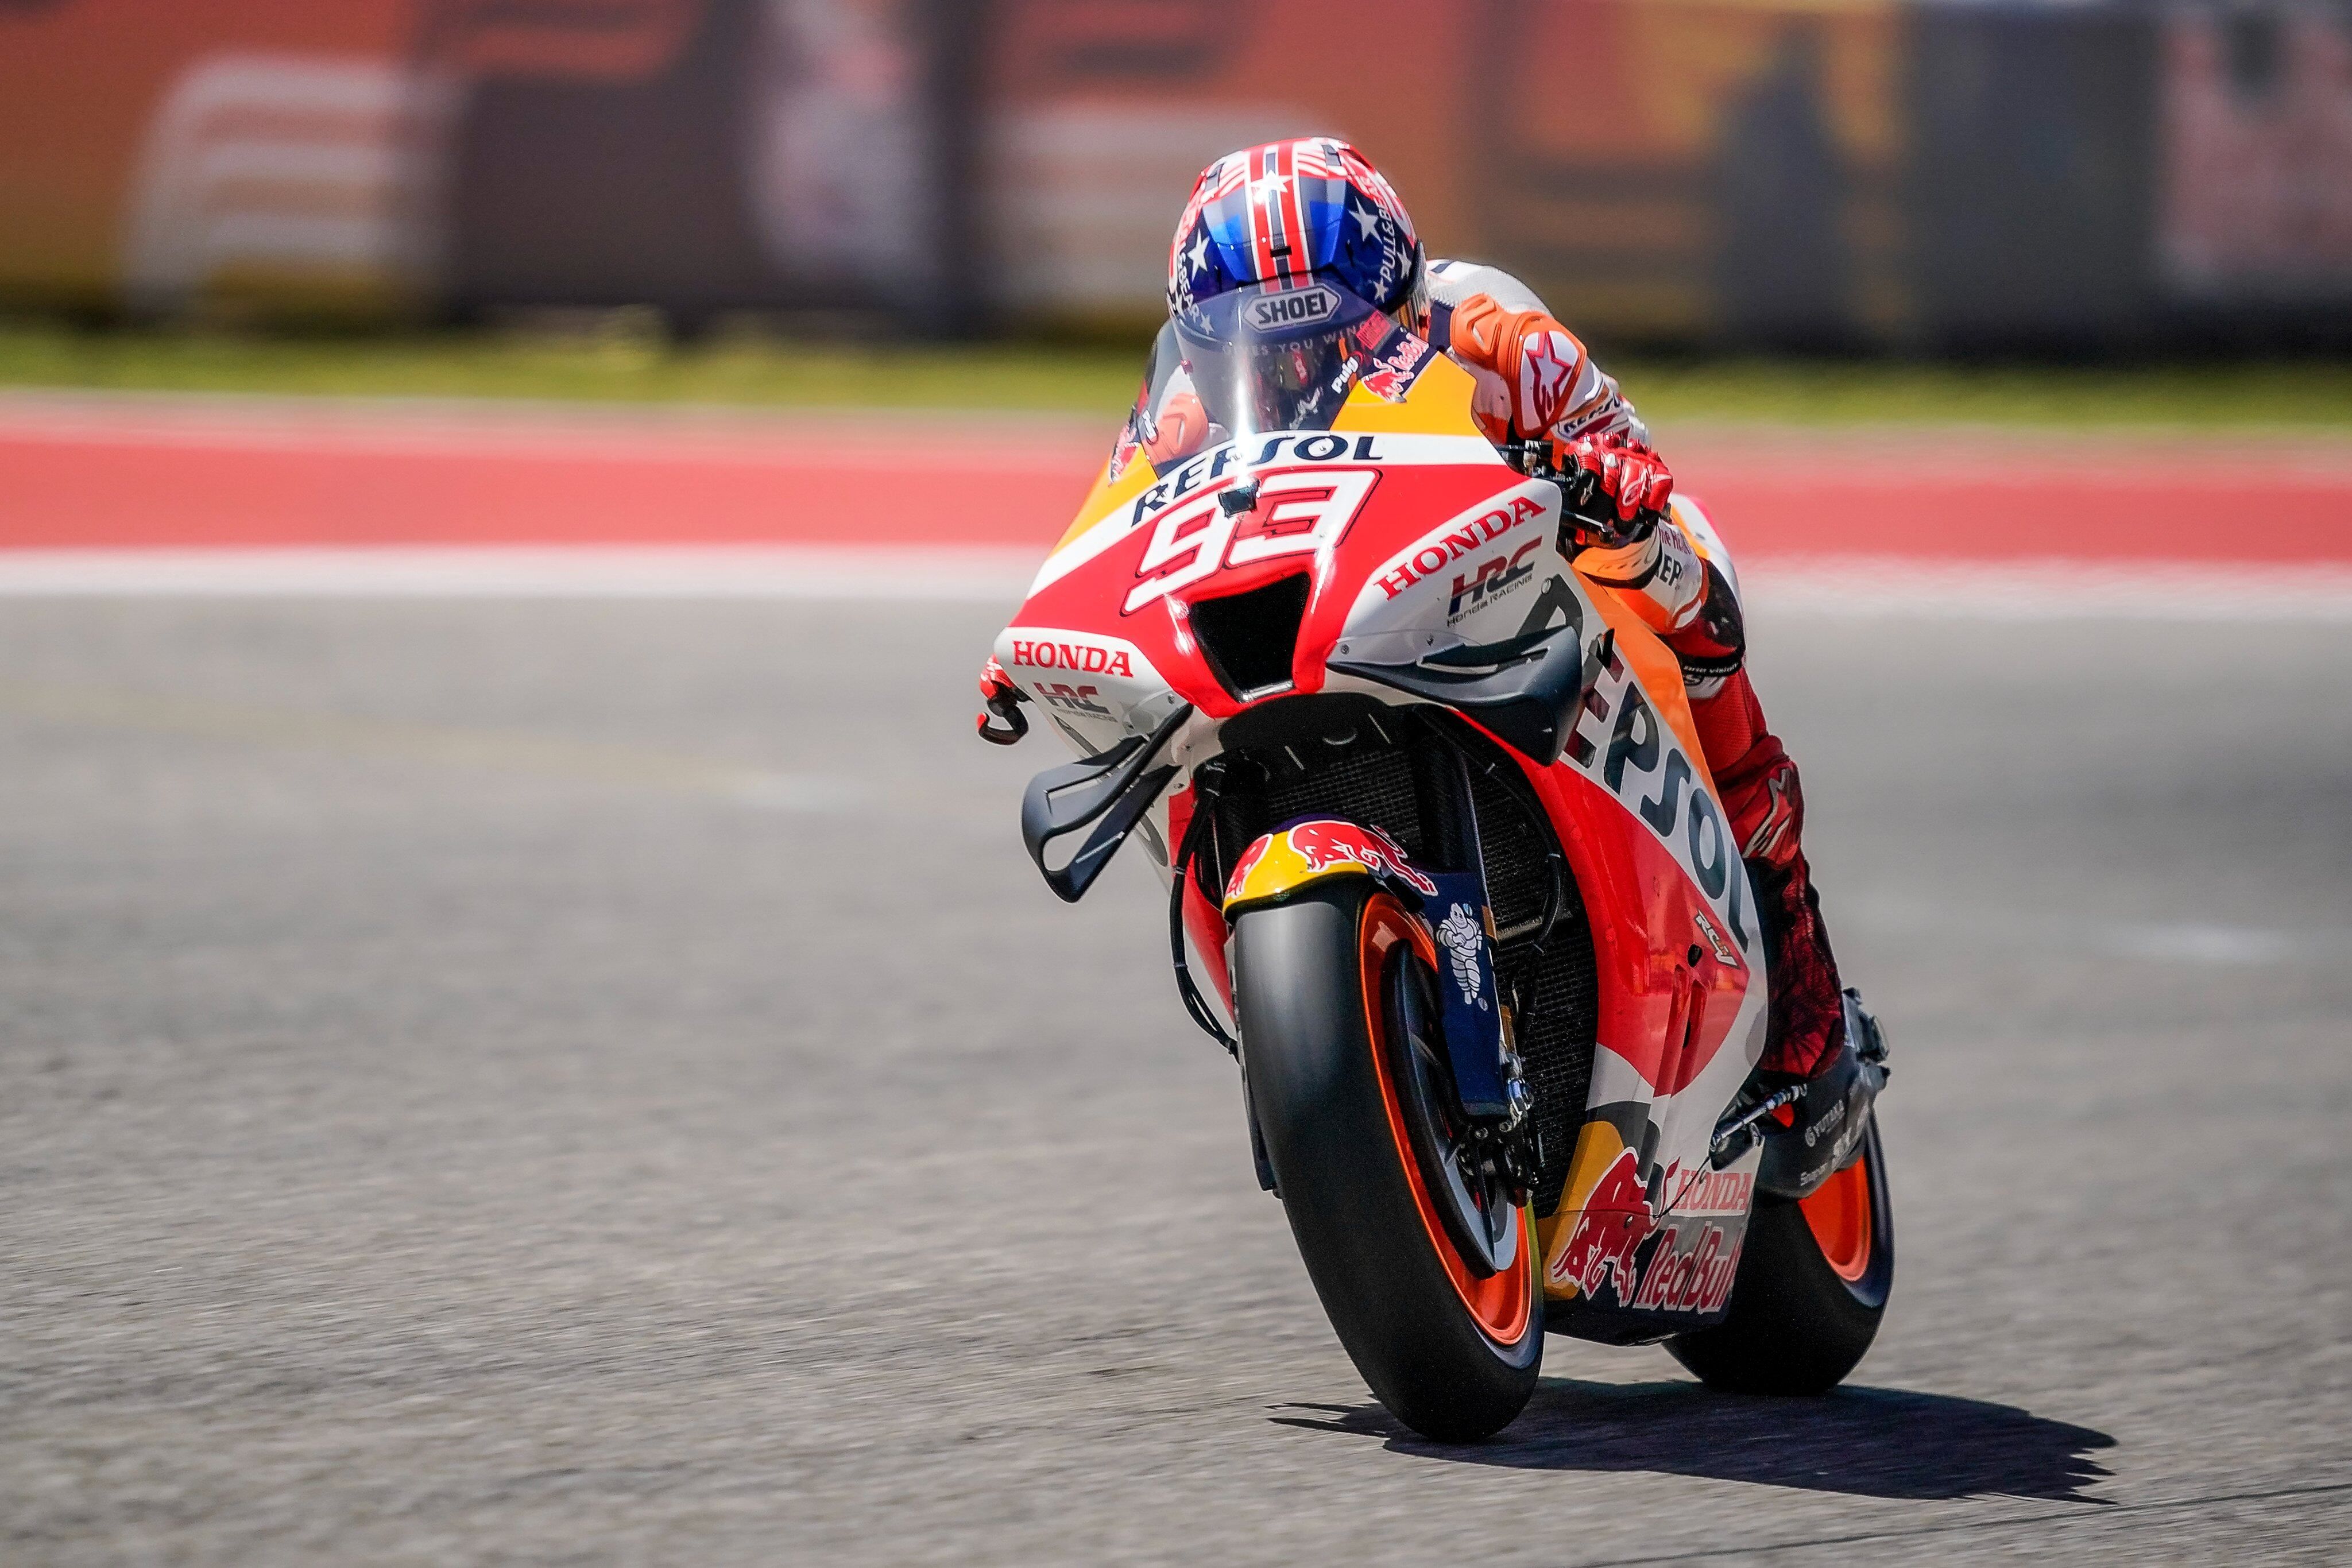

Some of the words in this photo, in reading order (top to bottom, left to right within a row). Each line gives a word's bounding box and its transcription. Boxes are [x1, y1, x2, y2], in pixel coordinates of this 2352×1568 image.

[1255, 292, 1328, 324] SHOEI
[1121, 467, 1383, 616] 93
[1373, 496, 1546, 601] HONDA
[1448, 535, 1543, 617] HRC
[1013, 640, 1134, 678] HONDA
[1033, 682, 1111, 715] HRC
[1671, 1169, 1752, 1210] HONDA
